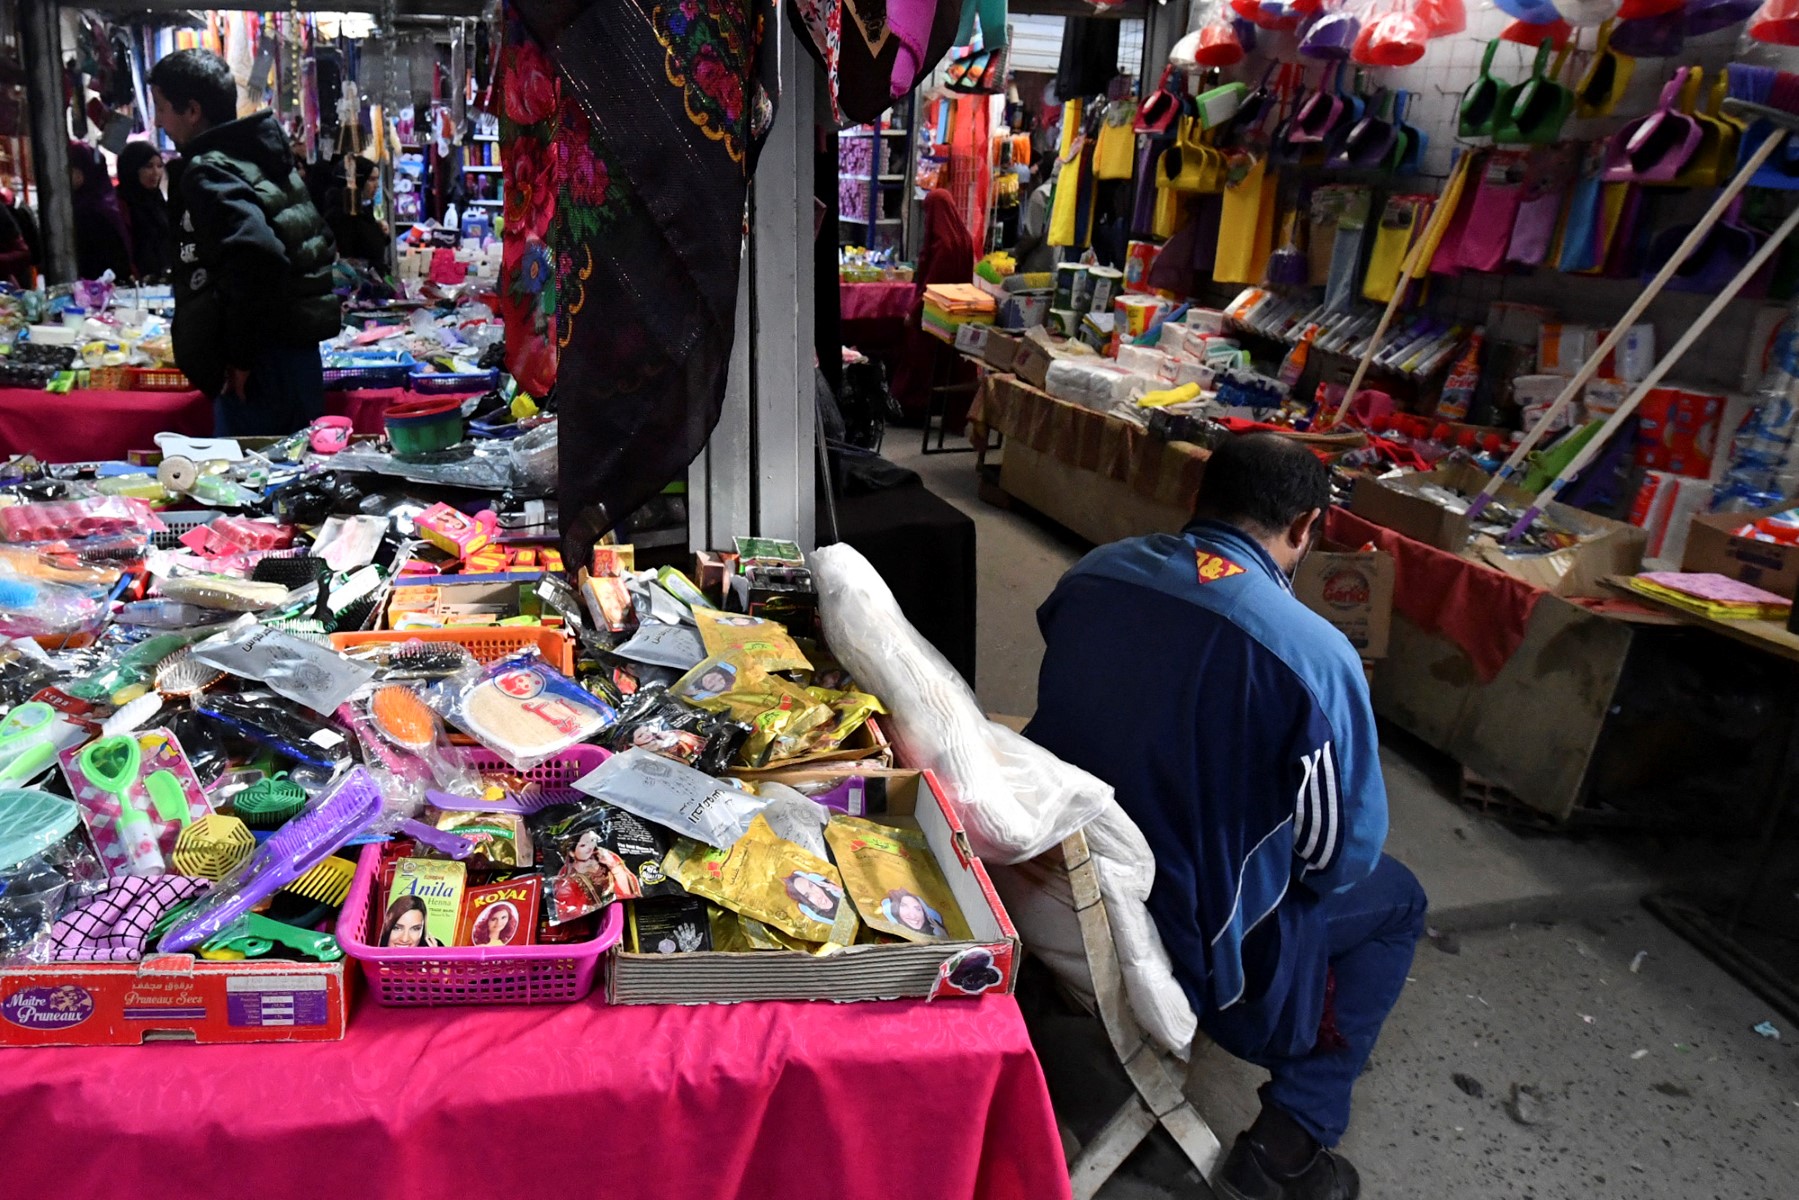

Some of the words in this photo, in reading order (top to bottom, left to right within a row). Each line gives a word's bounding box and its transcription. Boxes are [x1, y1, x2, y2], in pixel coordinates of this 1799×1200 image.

[398, 877, 454, 898] Anila
[427, 898, 452, 906] Henna
[472, 887, 527, 908] ROYAL
[124, 991, 173, 1006] Pruneaux
[175, 991, 204, 1006] Secs
[16, 1005, 84, 1024] Pruneaux
